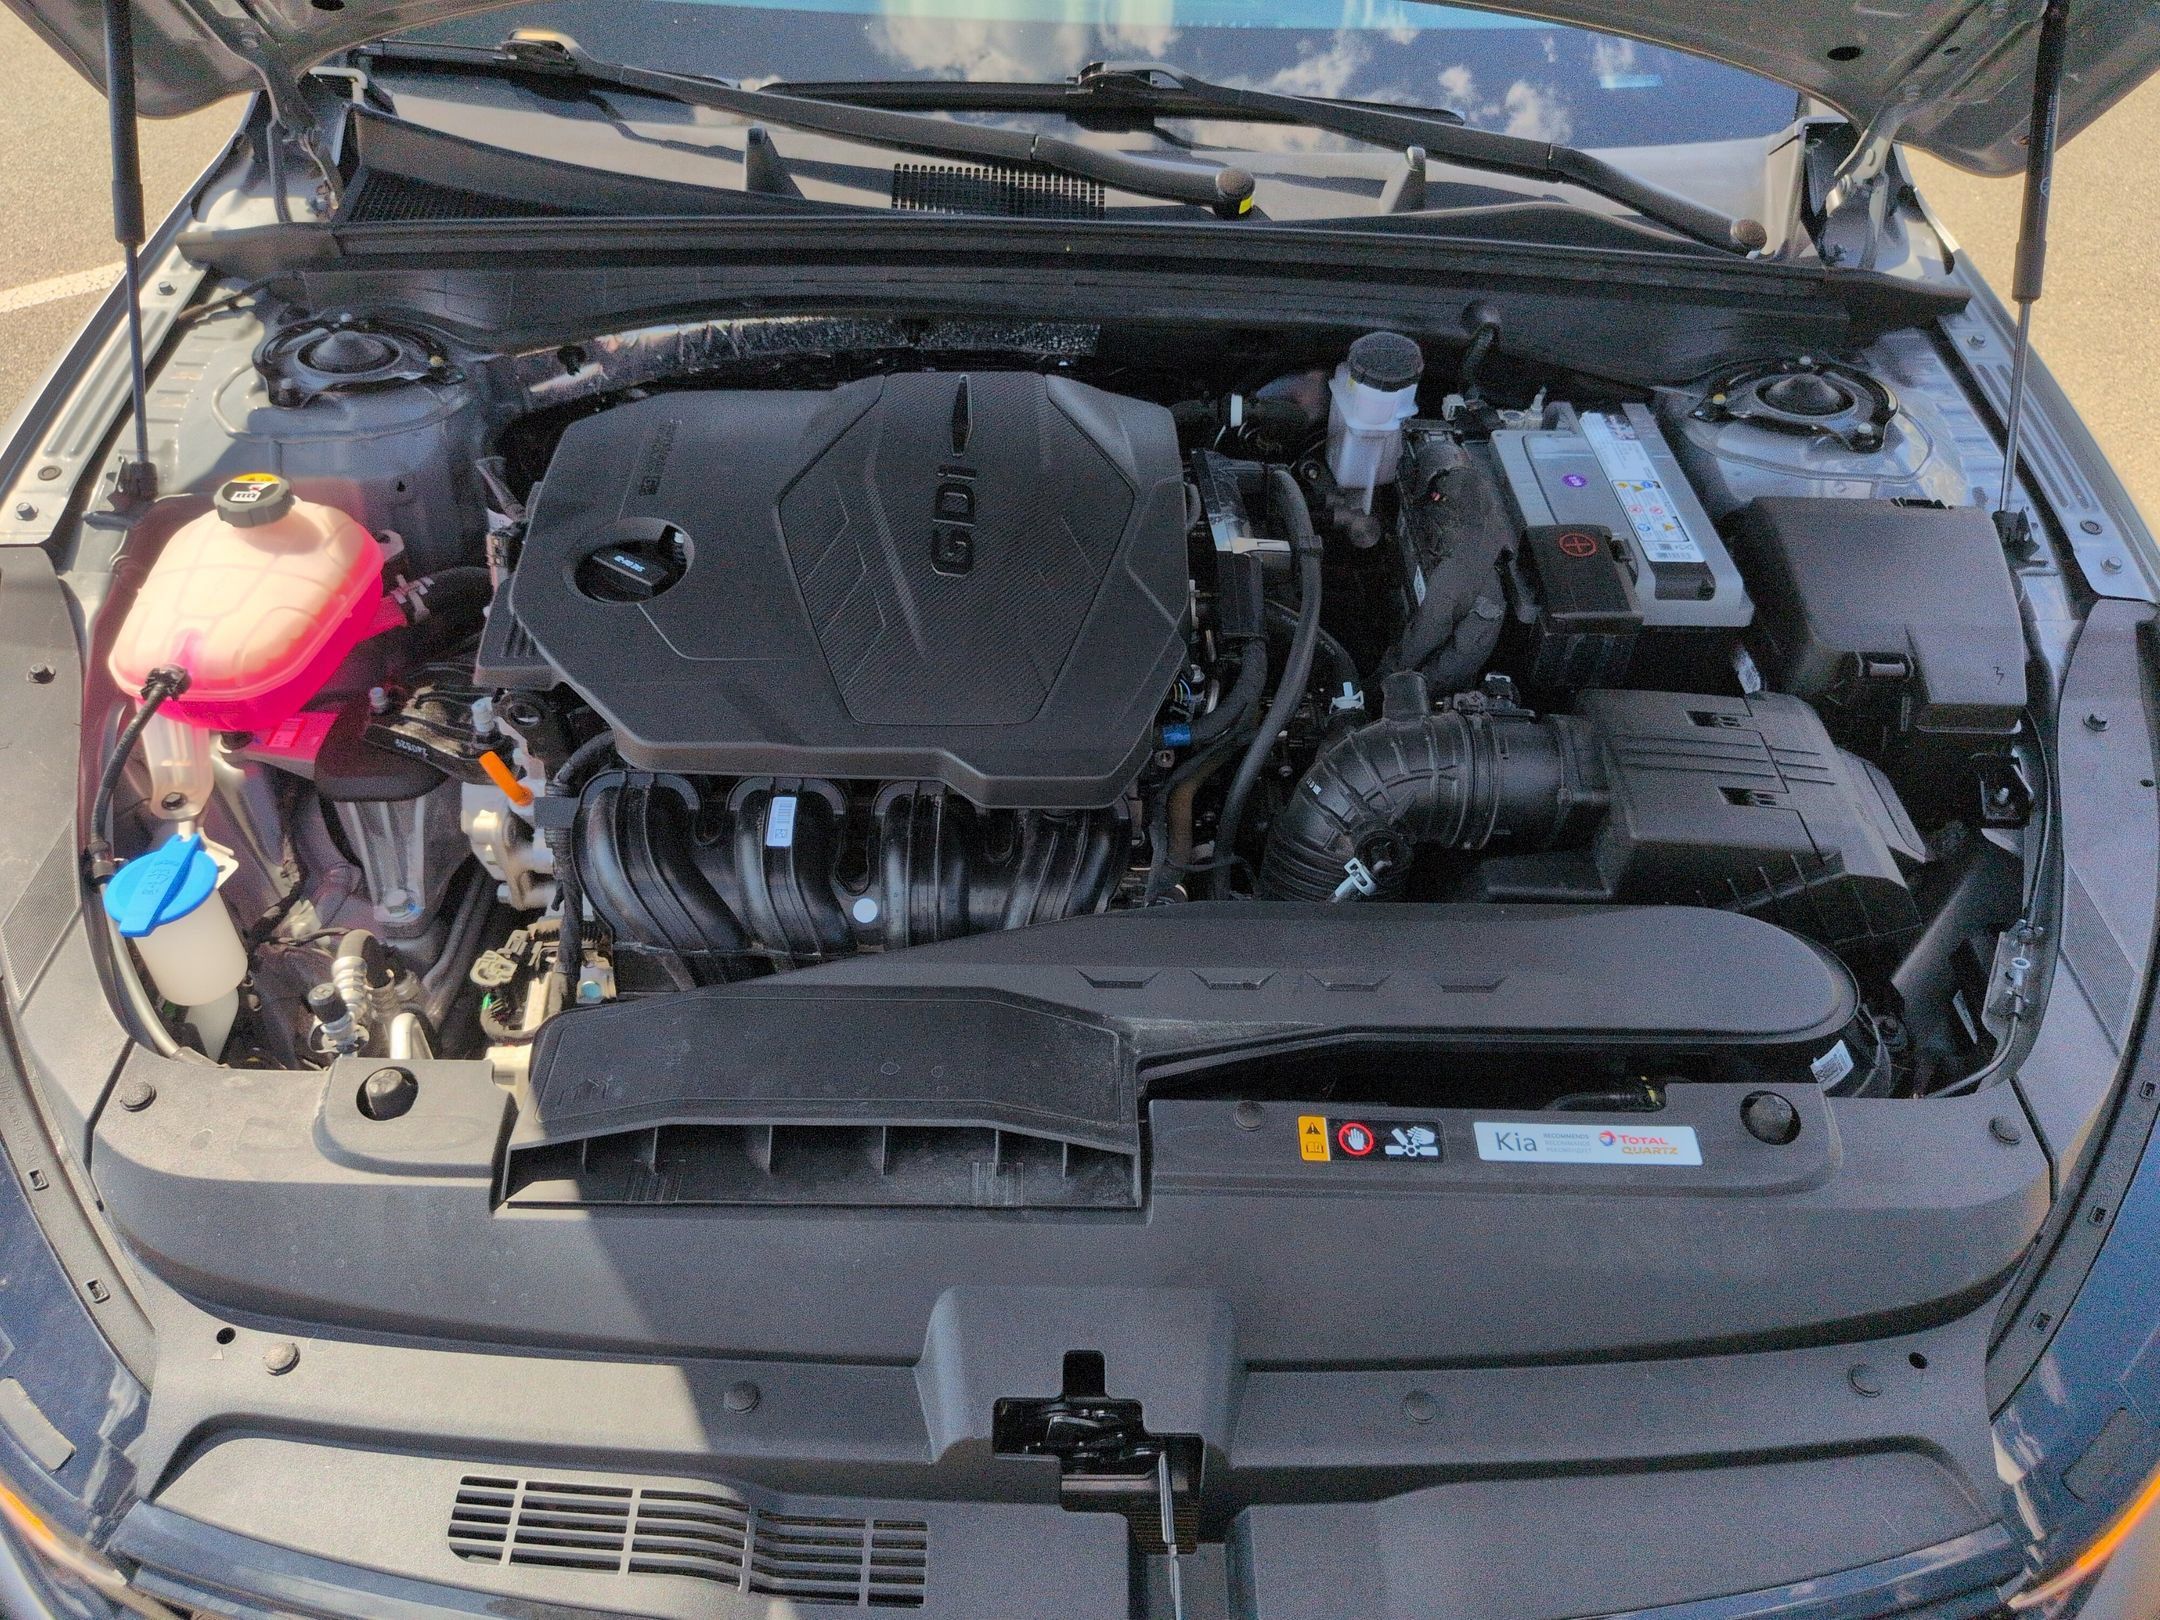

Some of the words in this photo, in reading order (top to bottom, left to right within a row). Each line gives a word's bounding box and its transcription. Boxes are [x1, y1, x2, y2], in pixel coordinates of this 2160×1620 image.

[1494, 1131, 1538, 1152] Kia
[1618, 1134, 1669, 1145] TOTAL
[1621, 1146, 1679, 1155] QUARTZ
